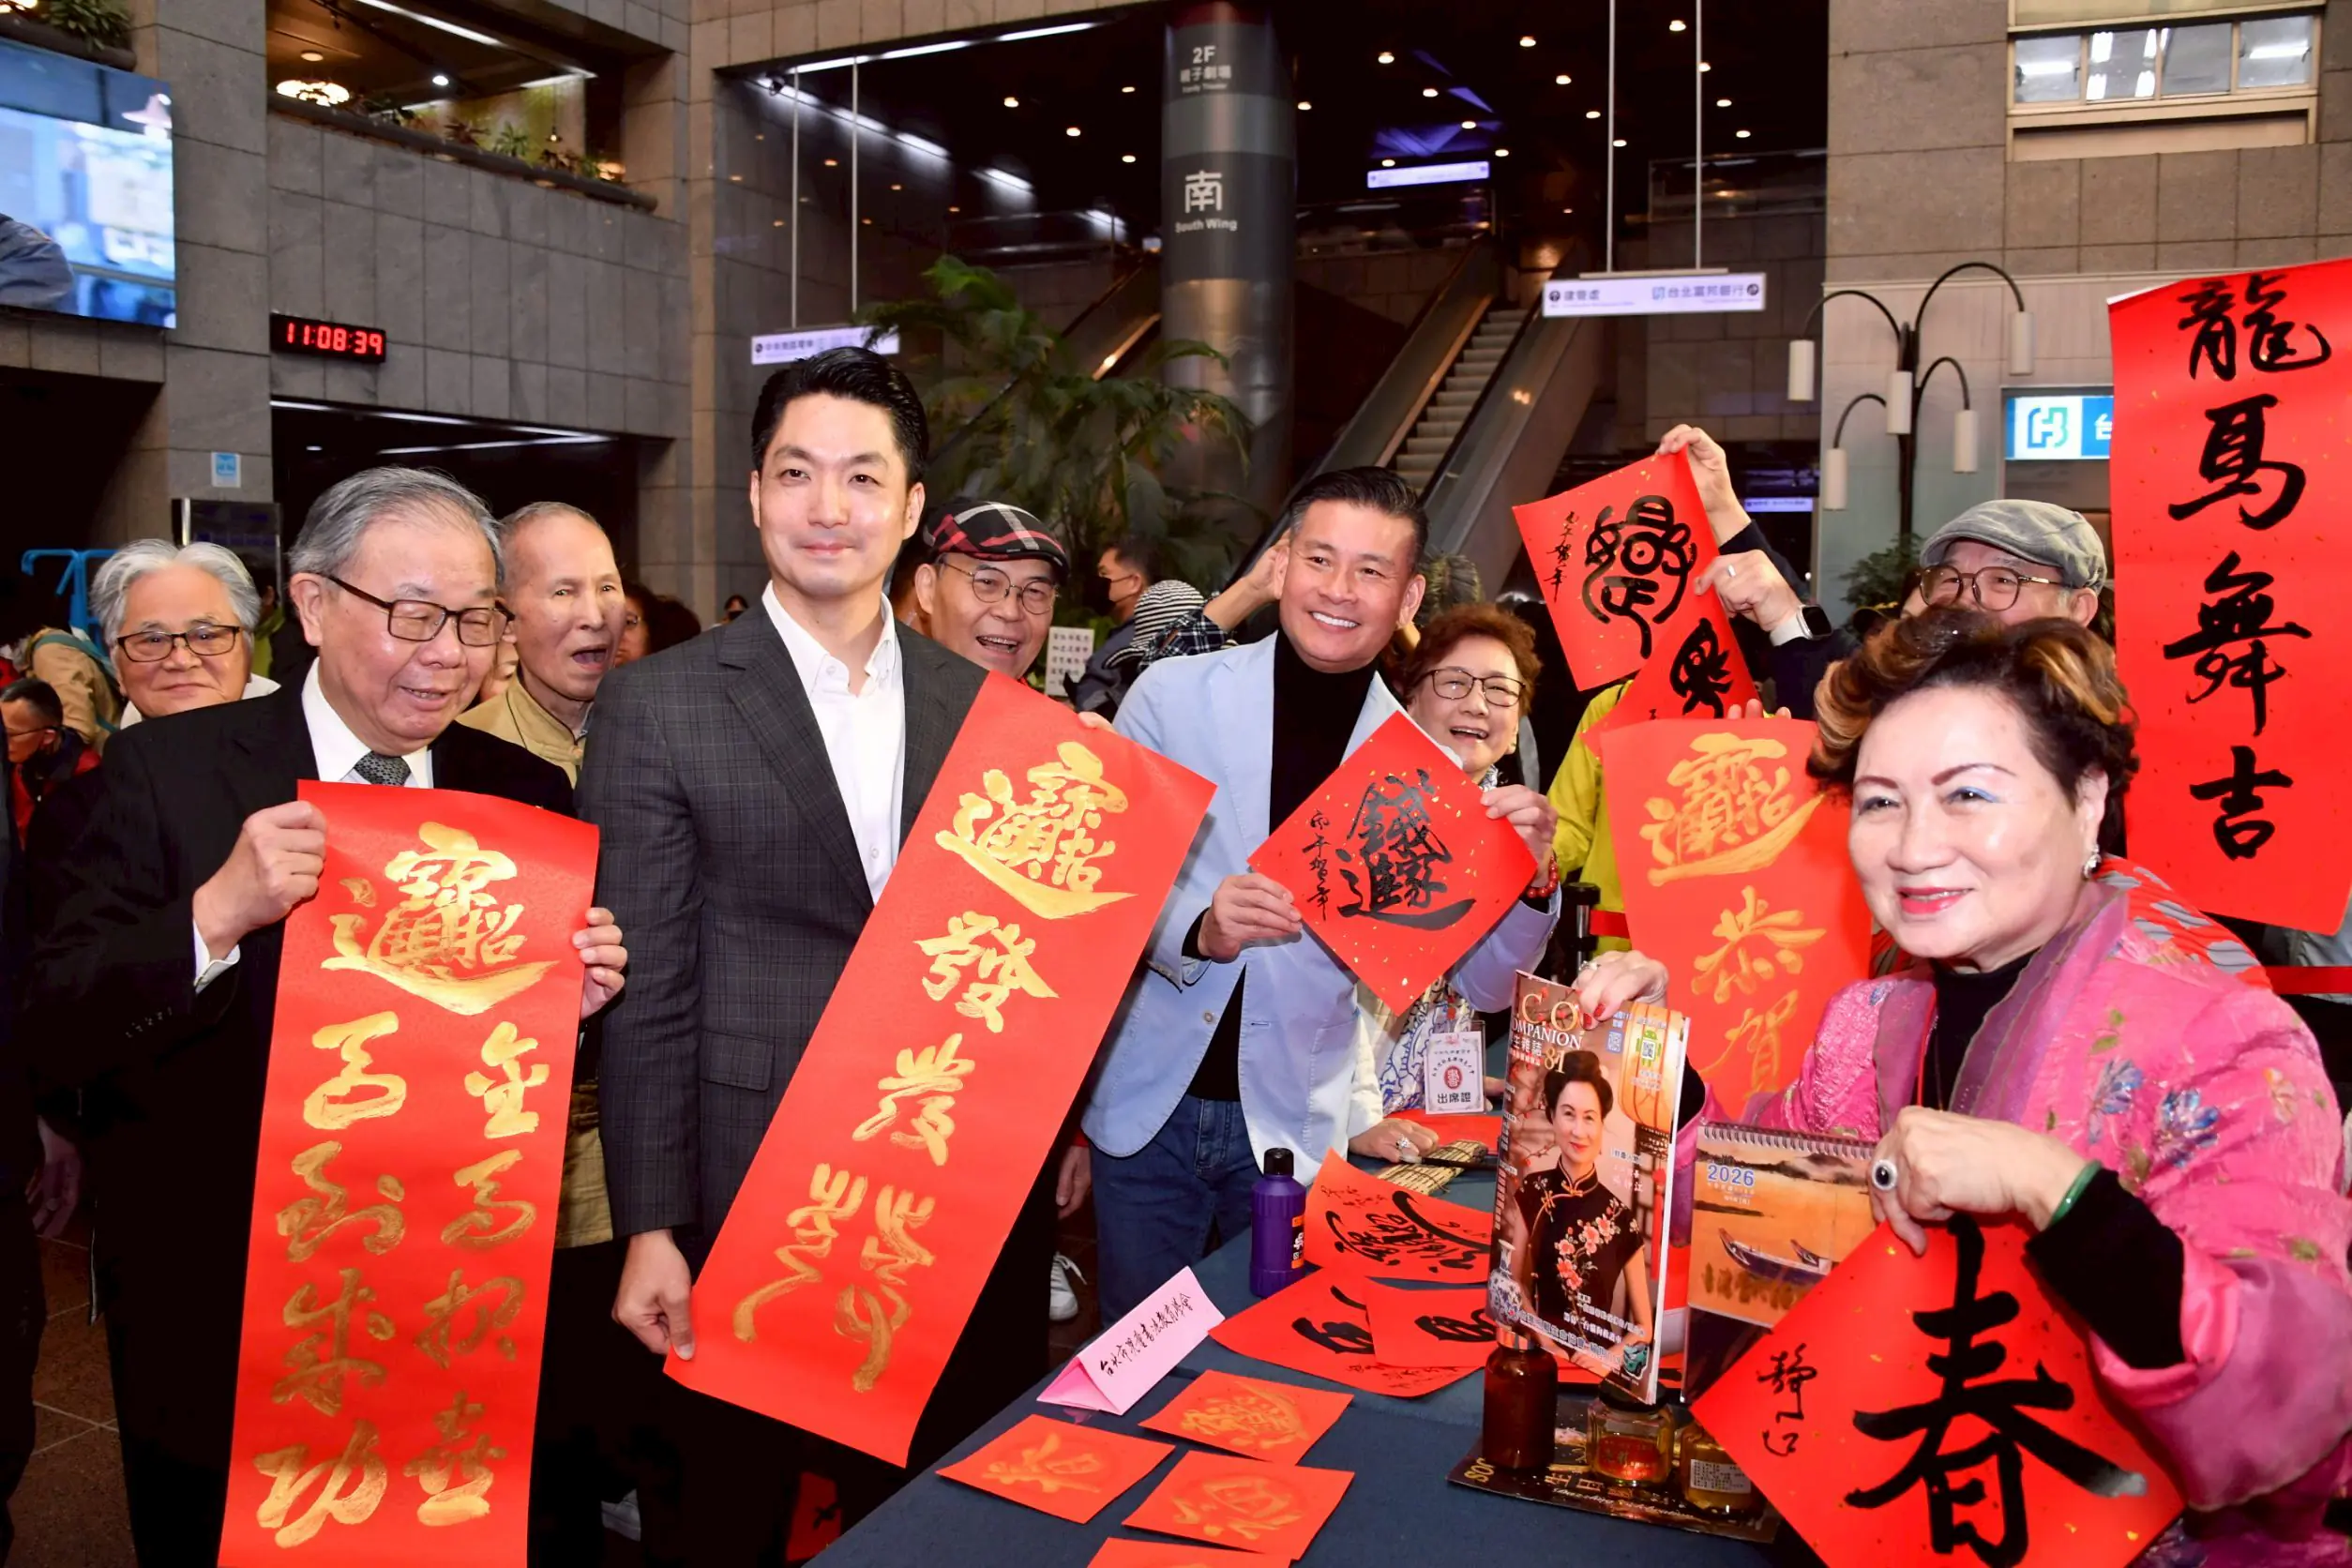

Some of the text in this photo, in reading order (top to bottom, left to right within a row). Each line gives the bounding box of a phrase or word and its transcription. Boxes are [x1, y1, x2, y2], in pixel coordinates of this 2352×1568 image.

[1192, 45, 1216, 64] 2F
[1184, 170, 1223, 213] 南
[1175, 218, 1238, 234] South Wing
[286, 322, 384, 355] 11:08:39
[1511, 1018, 1585, 1051] OMPANION
[1437, 1092, 1471, 1105] 出席證
[1706, 1163, 1756, 1188] 2026
[1843, 1213, 2148, 1568] 春
